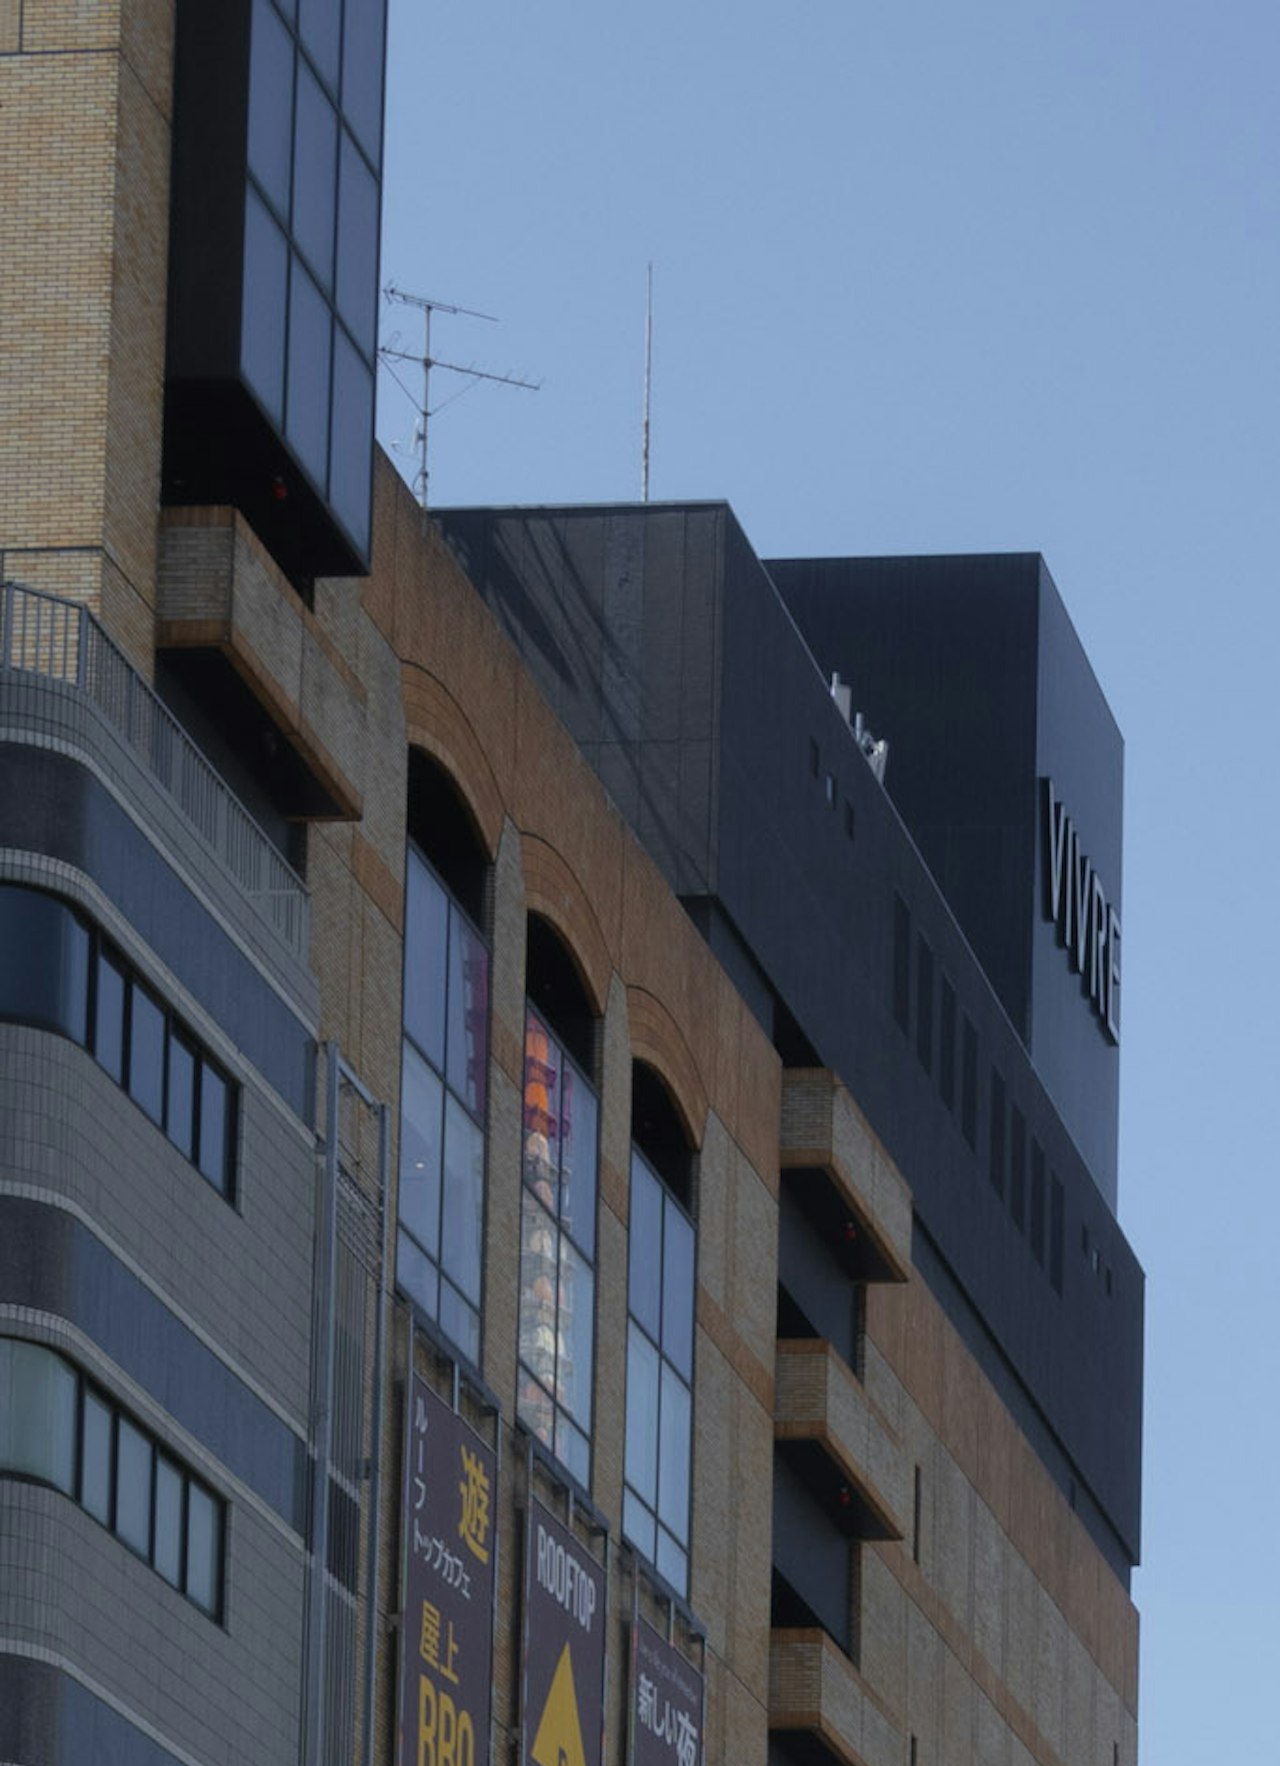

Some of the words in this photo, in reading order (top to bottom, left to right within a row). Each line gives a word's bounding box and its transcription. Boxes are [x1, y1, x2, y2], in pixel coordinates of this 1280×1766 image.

[1041, 777, 1121, 1046] VIVRE
[537, 1524, 596, 1632] ROOFTOP
[419, 1600, 459, 1687] 屋上
